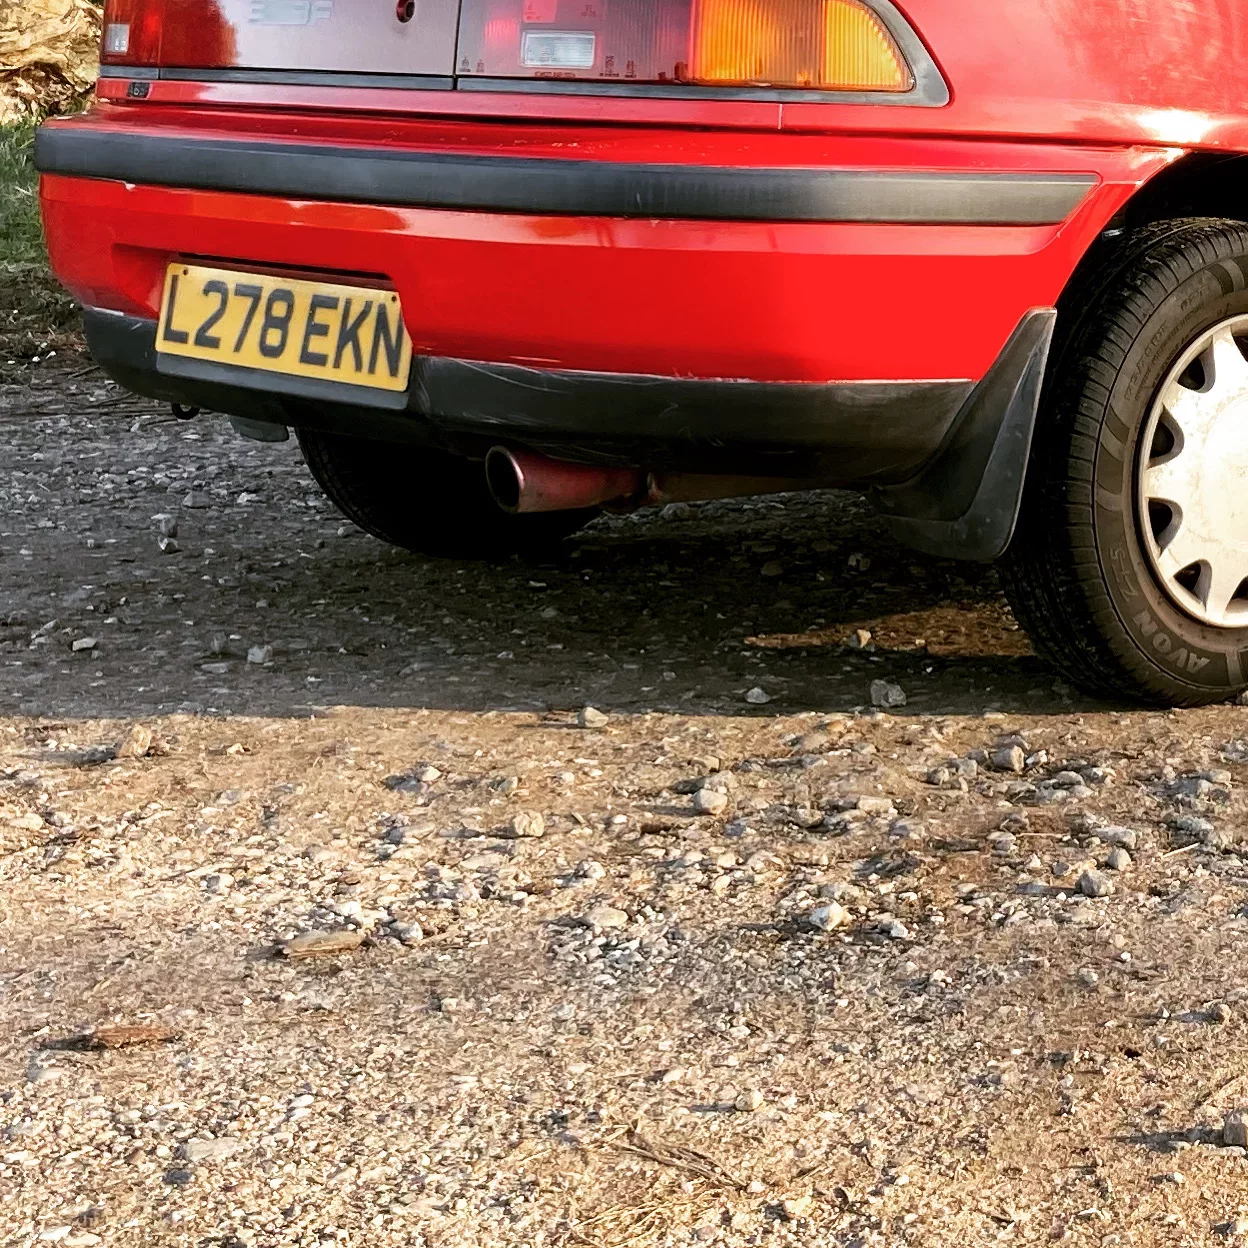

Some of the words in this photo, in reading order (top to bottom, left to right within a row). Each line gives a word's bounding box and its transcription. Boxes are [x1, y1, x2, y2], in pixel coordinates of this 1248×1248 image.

[162, 274, 296, 359] L278
[299, 293, 405, 378] EKN
[1131, 608, 1211, 674] AVON
